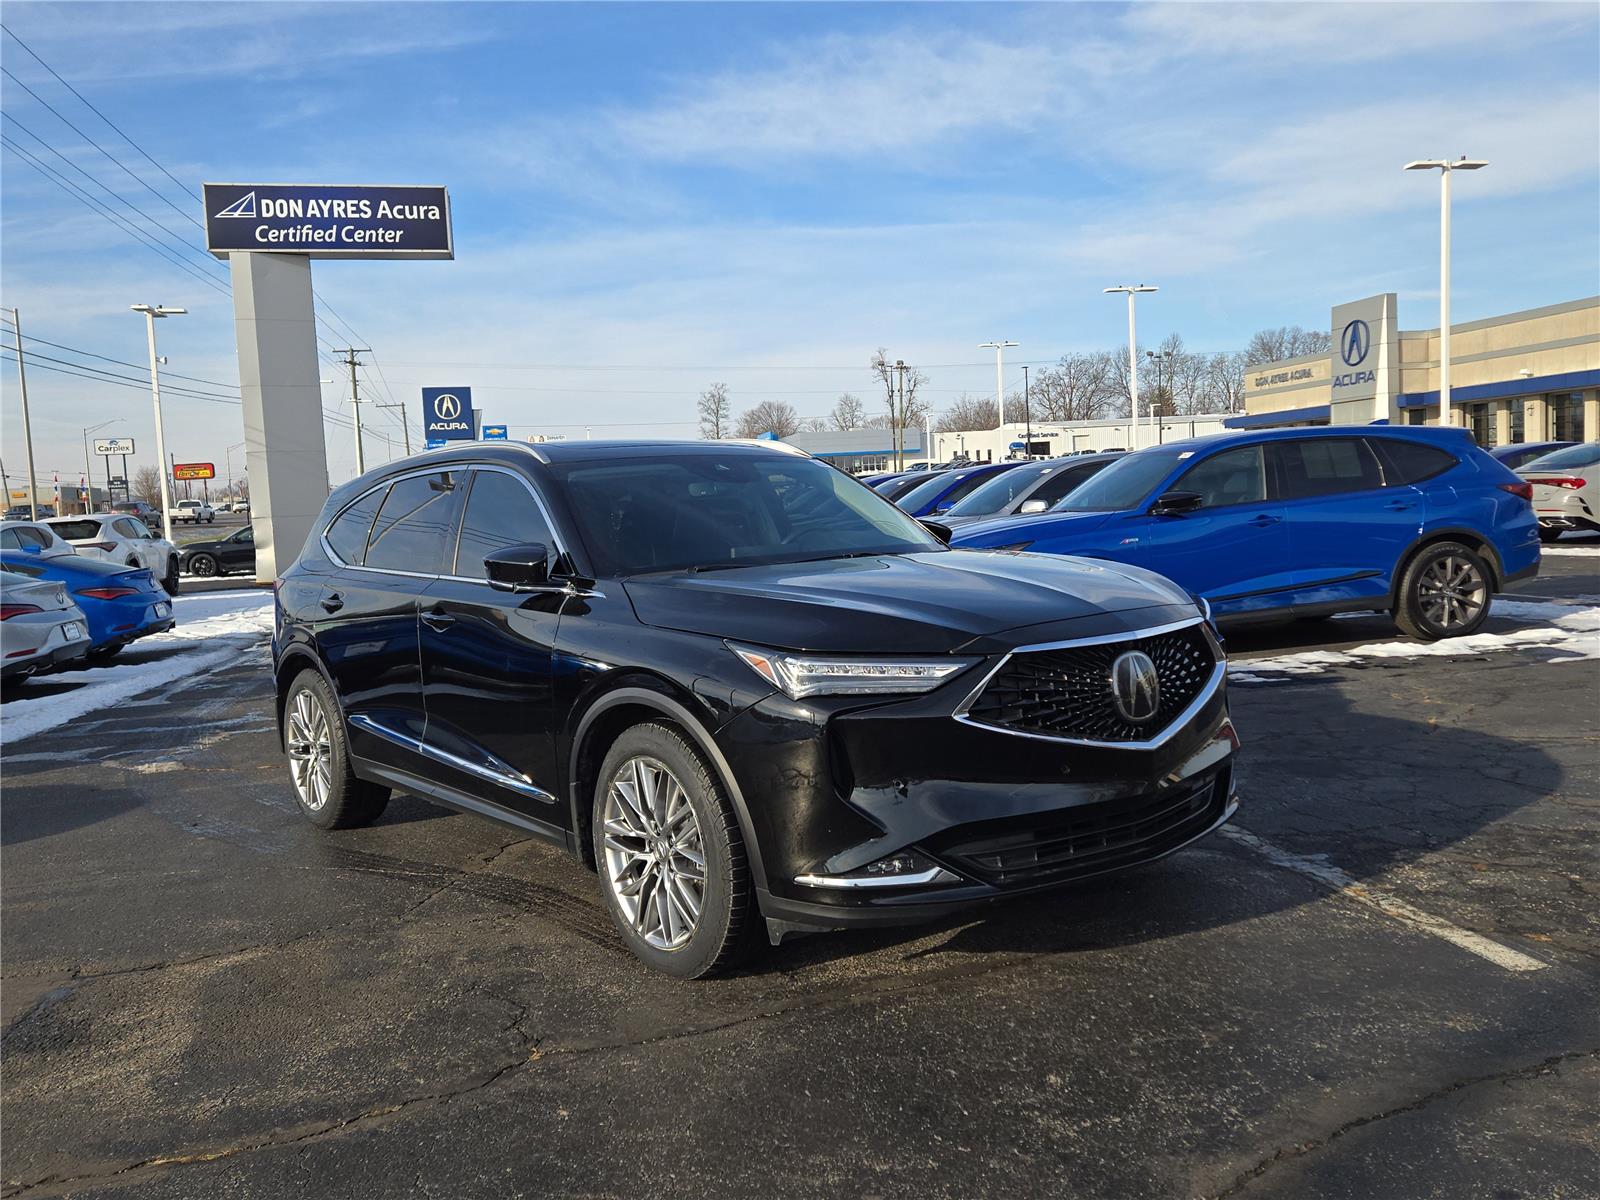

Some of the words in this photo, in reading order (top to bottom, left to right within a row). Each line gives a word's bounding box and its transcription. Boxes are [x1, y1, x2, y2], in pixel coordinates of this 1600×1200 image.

[261, 199, 303, 218] DON
[306, 199, 372, 219] AYRES
[376, 200, 440, 220] Acura
[255, 224, 337, 243] Certified
[341, 225, 404, 243] Center
[1332, 370, 1376, 388] ACURA
[429, 422, 469, 431] ACURA
[97, 444, 130, 454] Carplex
